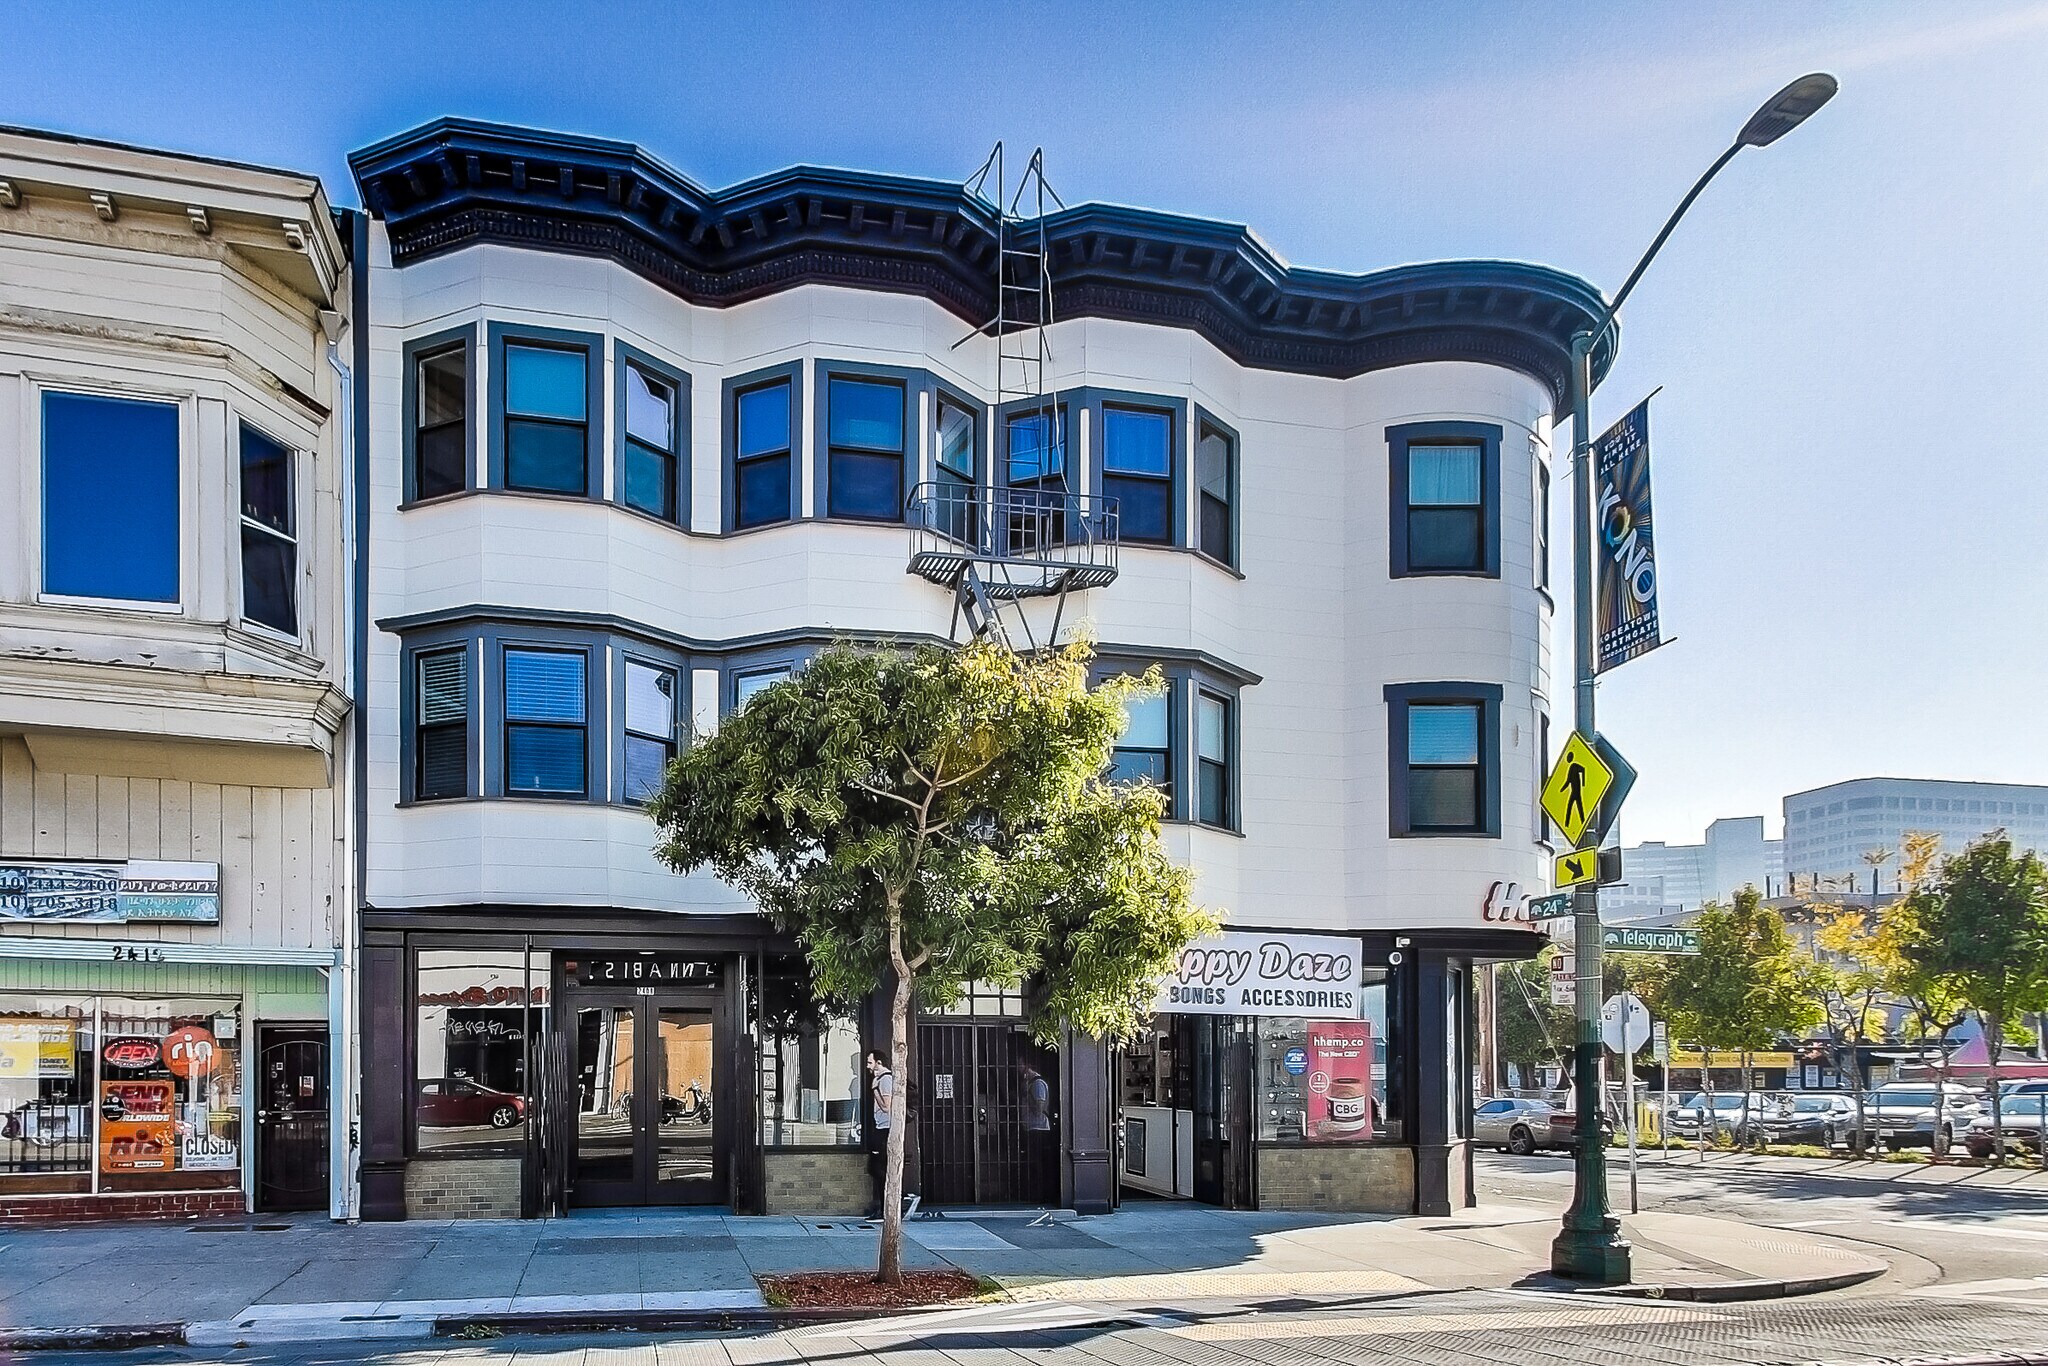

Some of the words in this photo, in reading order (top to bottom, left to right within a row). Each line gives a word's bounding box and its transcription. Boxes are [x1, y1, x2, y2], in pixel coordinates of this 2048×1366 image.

[1599, 482, 1656, 603] KONO
[1620, 928, 1683, 950] Telegraph
[1178, 949, 1252, 986] ppy
[1258, 942, 1351, 982] Daze
[1170, 986, 1226, 1005] BONGS
[1241, 988, 1353, 1008] ACCESSORIES
[1313, 1035, 1364, 1049] hhemp.co
[105, 1046, 158, 1061] OPEN
[121, 1114, 170, 1122] RLDWIDE
[1335, 1104, 1359, 1114] CBG
[185, 1138, 234, 1156] CLOSED
